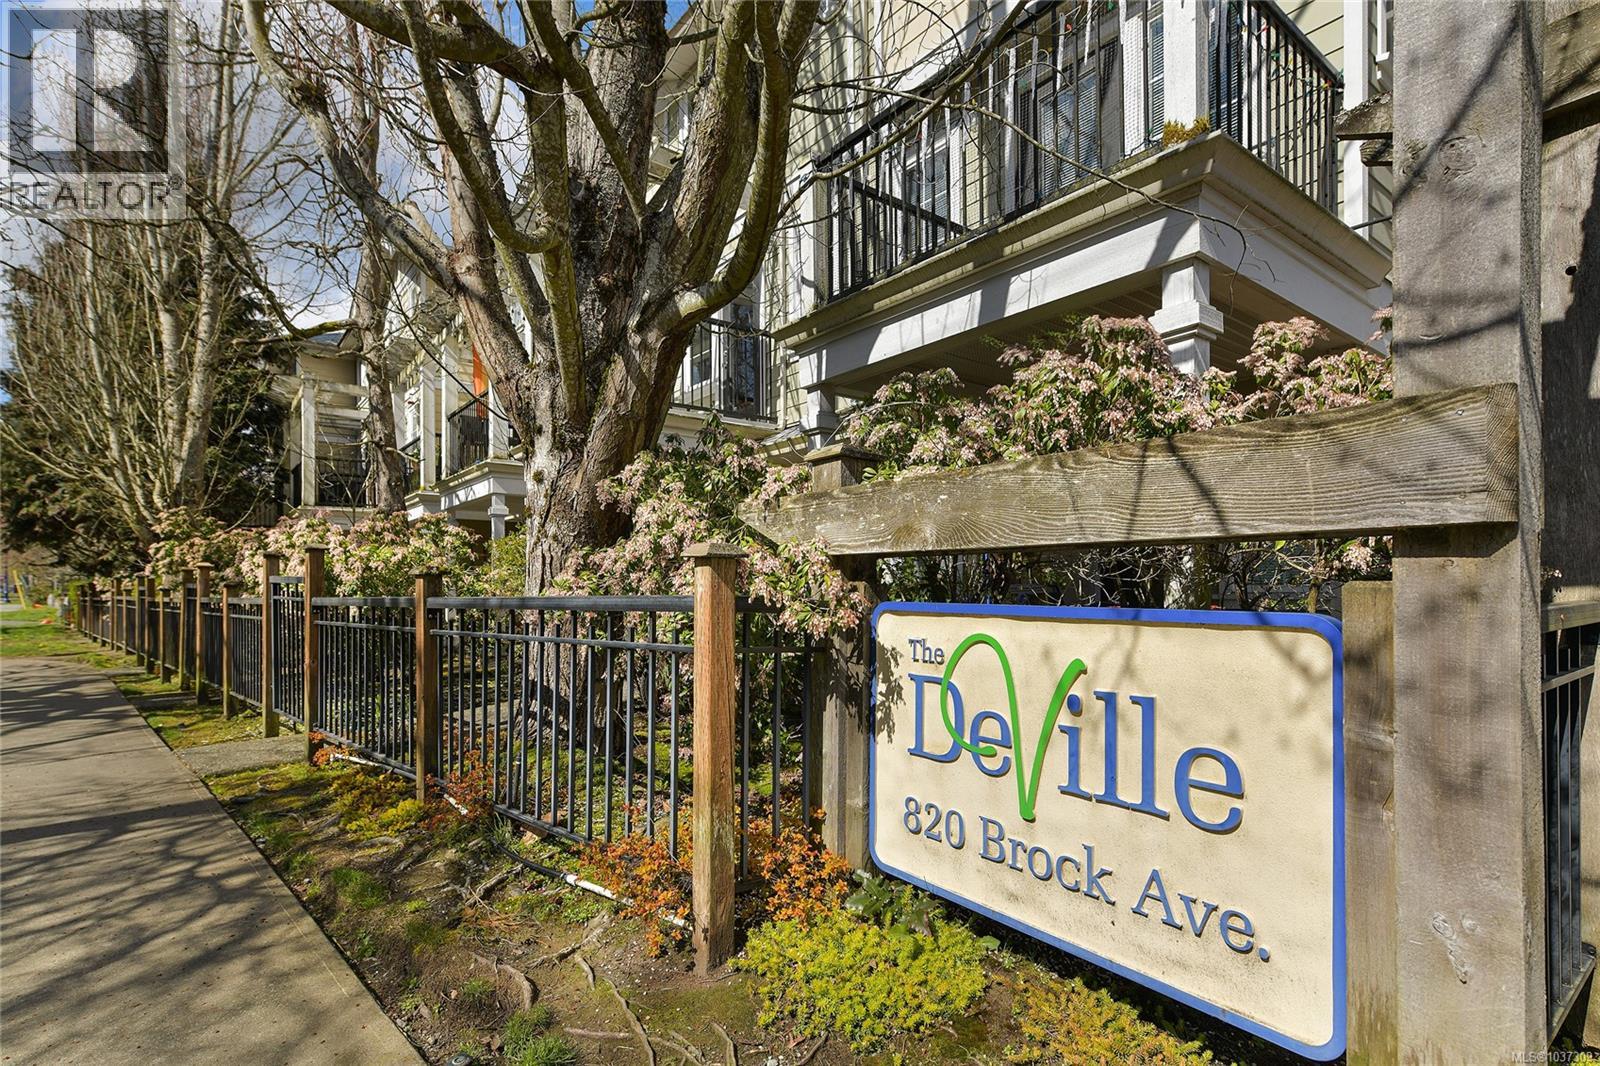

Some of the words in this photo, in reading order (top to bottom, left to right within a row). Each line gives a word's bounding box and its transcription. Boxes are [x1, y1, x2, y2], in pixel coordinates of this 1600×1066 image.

[907, 633, 1246, 834] DeVille
[908, 638, 945, 665] The
[902, 796, 966, 850] 820
[978, 815, 1116, 906] Brock
[1131, 868, 1271, 962] Ave.
